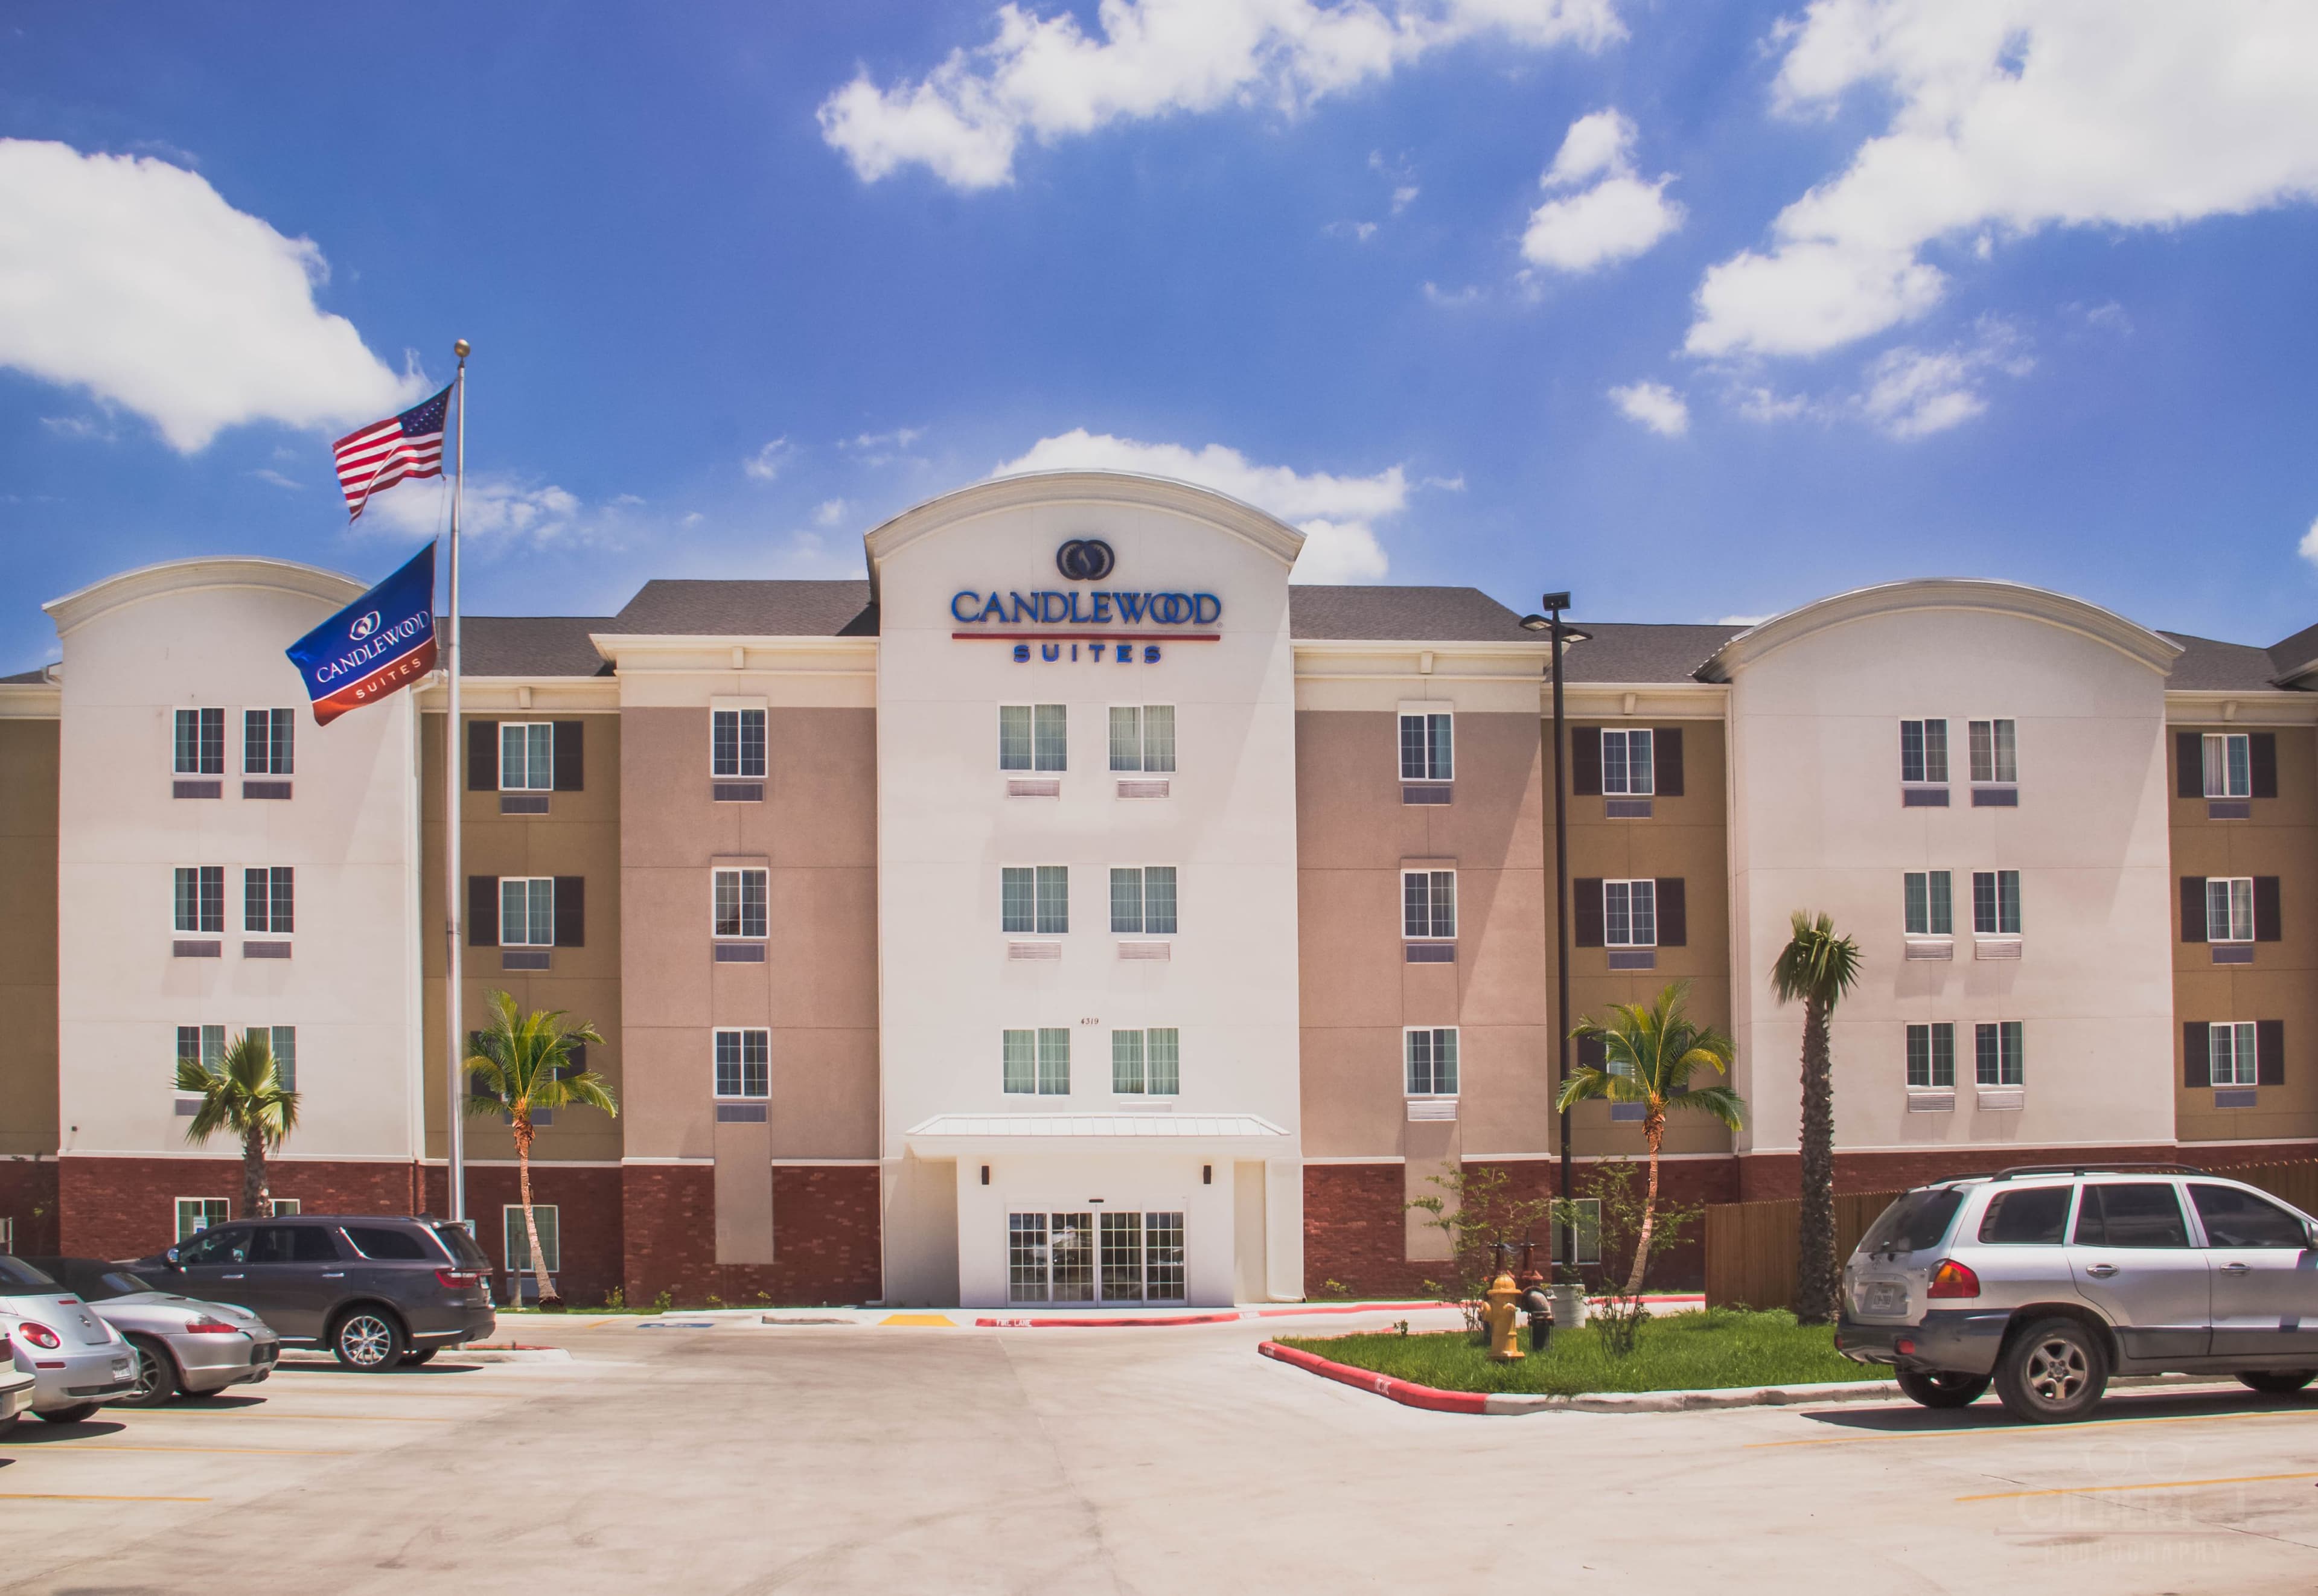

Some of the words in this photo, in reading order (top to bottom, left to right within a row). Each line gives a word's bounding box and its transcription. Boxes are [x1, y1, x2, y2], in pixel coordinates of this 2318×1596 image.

[951, 590, 1222, 625] CANDLEWOOD
[316, 610, 430, 683] CANDLEWOOD
[1014, 643, 1162, 664] SUITES
[355, 657, 422, 699] SUITES
